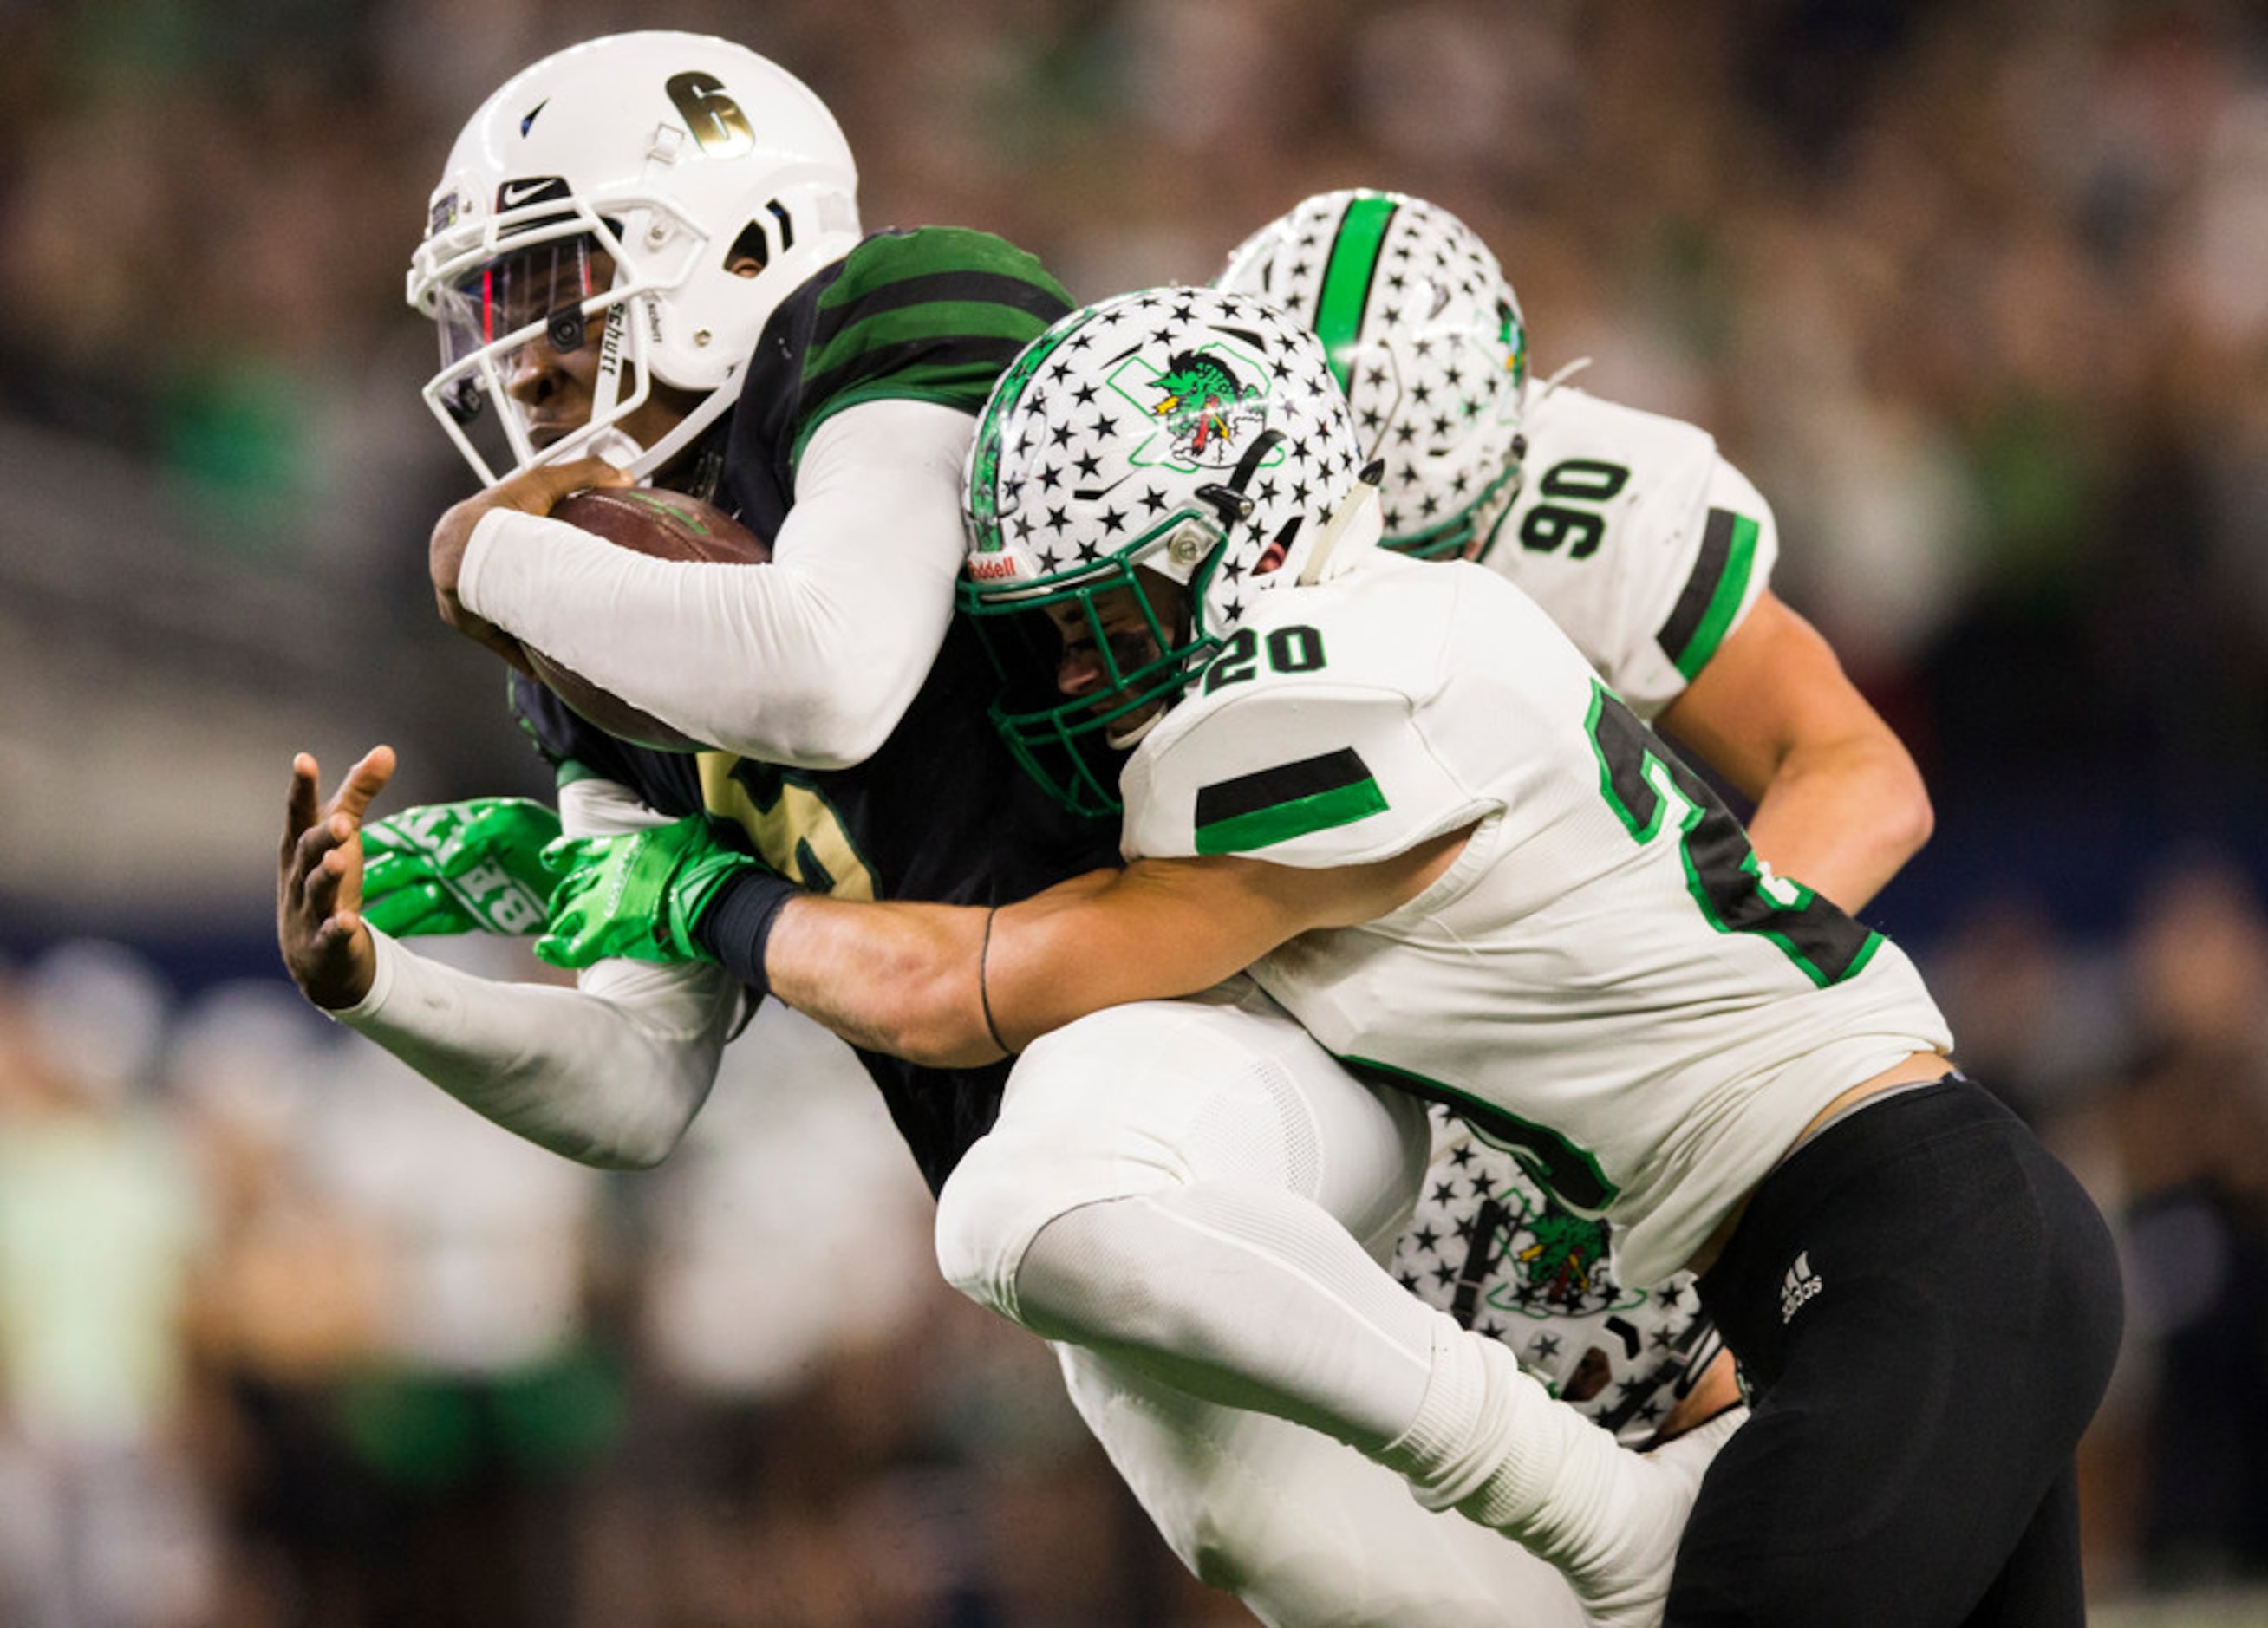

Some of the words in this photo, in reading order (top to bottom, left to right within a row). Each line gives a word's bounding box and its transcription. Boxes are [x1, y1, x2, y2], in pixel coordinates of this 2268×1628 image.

[665, 71, 756, 159] 6
[1520, 459, 1631, 560] 90
[968, 556, 1015, 579] ddell
[1204, 626, 1327, 698] 20
